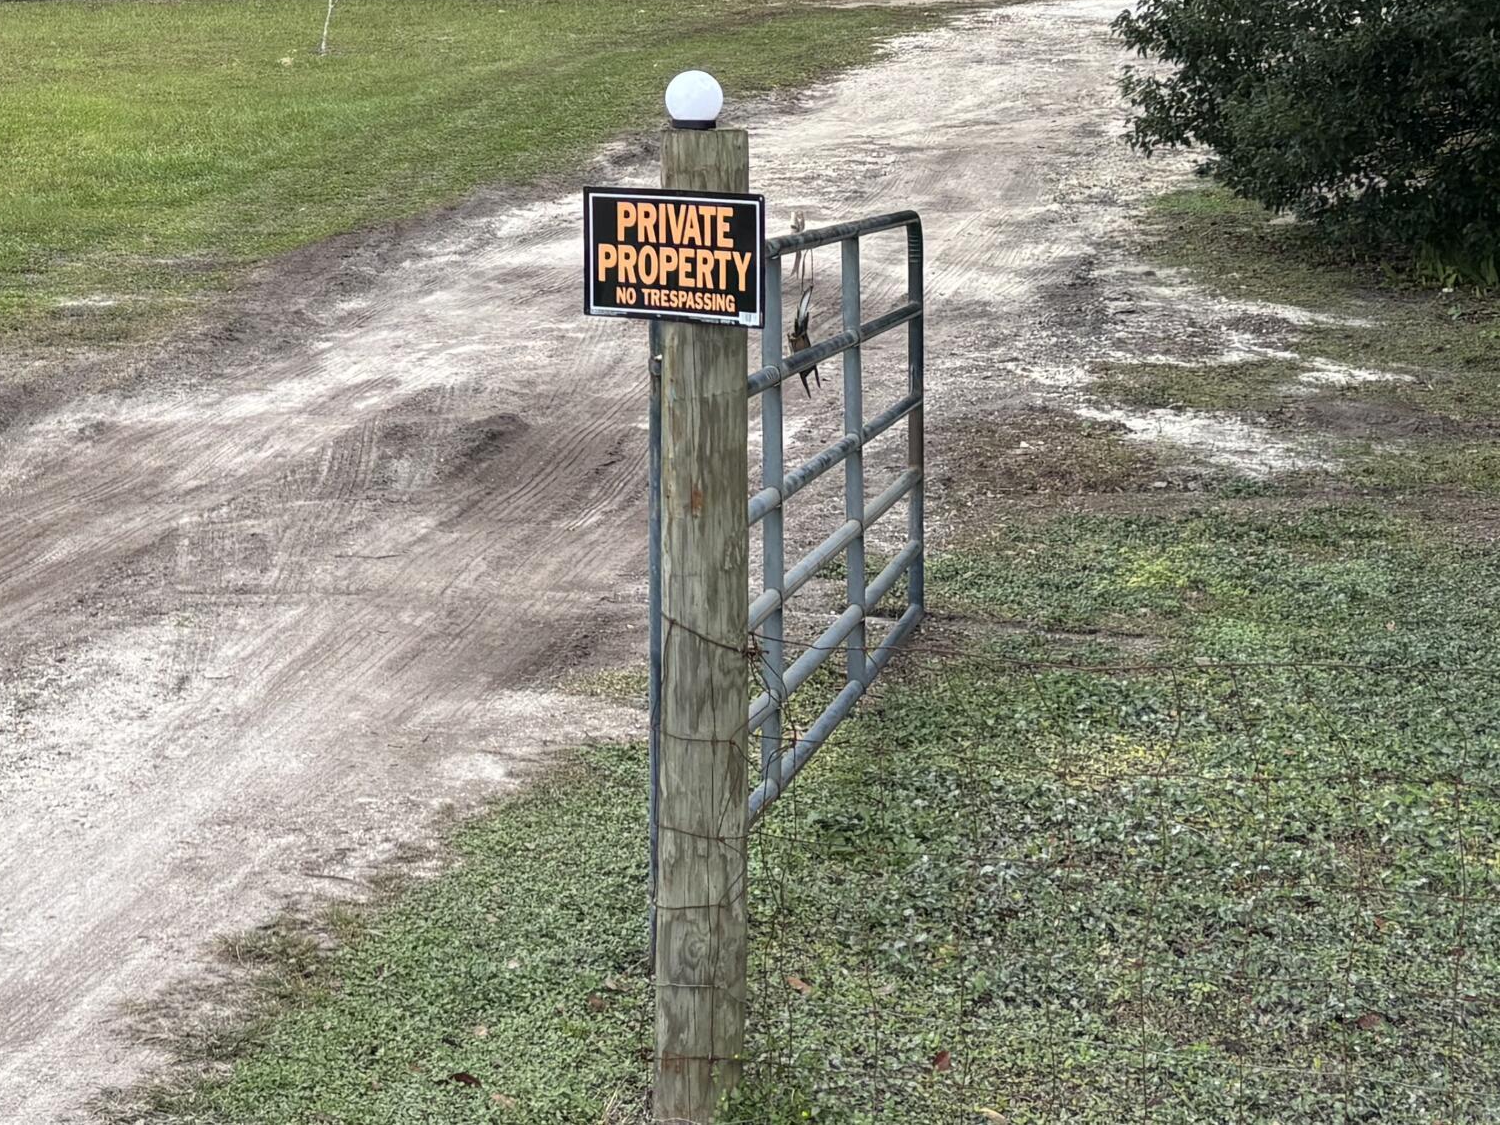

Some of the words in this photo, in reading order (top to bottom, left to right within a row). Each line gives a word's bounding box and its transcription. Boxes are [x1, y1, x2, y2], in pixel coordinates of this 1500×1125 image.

[616, 201, 734, 248] PRIVATE
[597, 243, 752, 292] PROPERTY
[616, 286, 637, 305] NO
[641, 288, 736, 312] TRESPASSING
